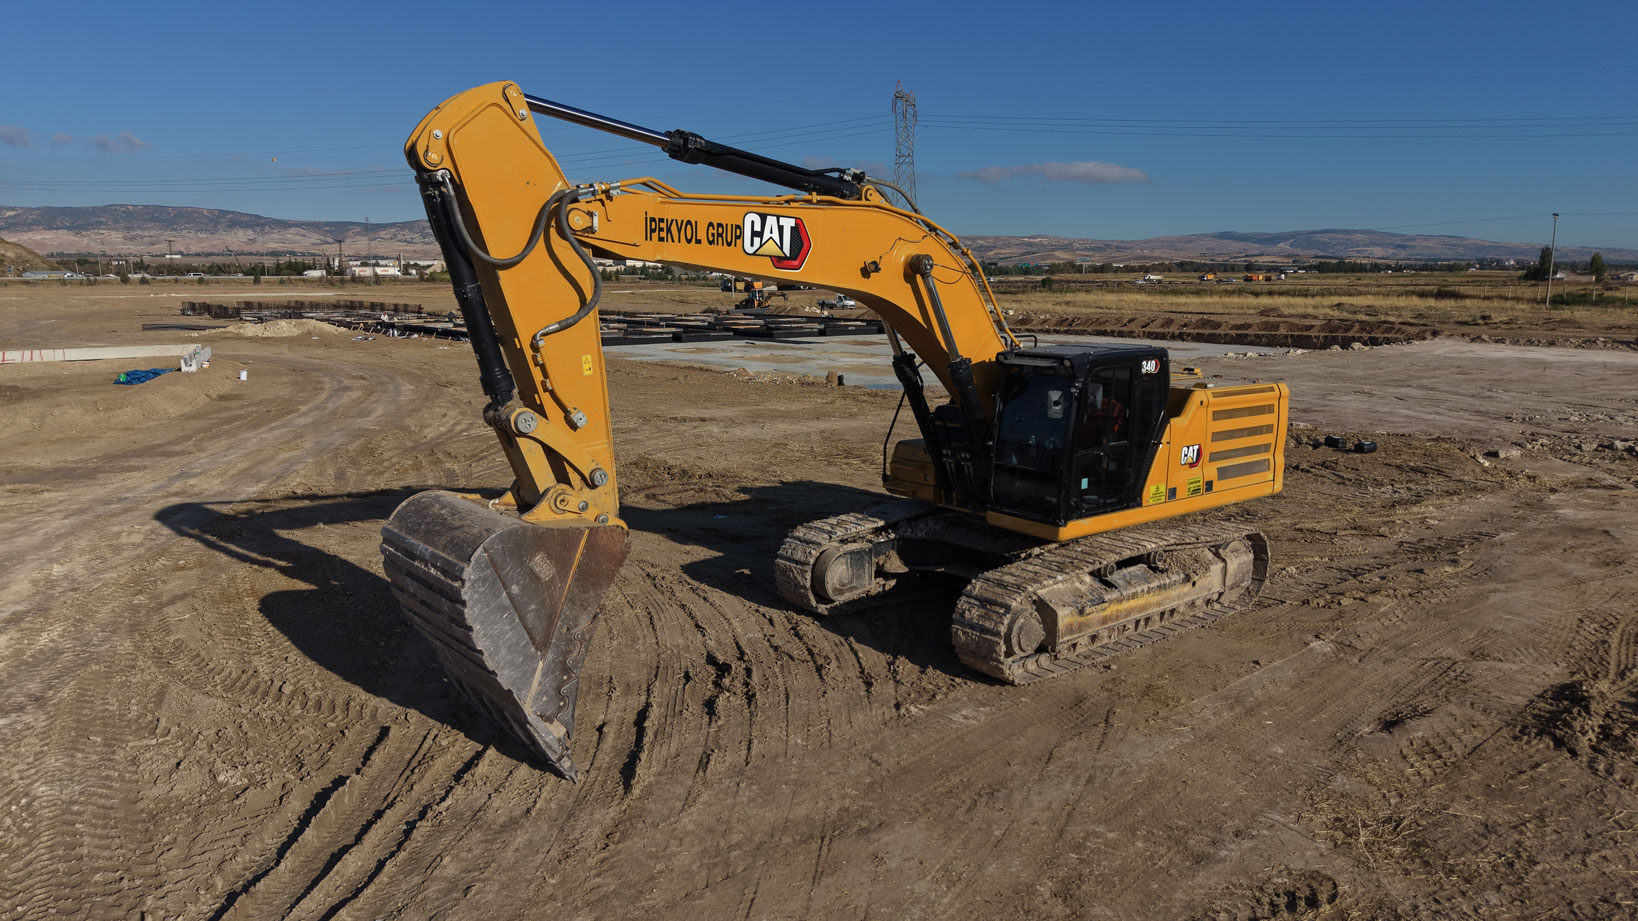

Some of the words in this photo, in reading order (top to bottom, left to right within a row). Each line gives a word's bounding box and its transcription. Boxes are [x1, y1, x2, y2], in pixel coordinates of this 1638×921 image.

[645, 211, 702, 244] İPEKYOL
[706, 221, 742, 247] GRUP
[744, 212, 796, 257] CAT
[1141, 360, 1156, 373] 340
[1181, 445, 1199, 465] CAT
